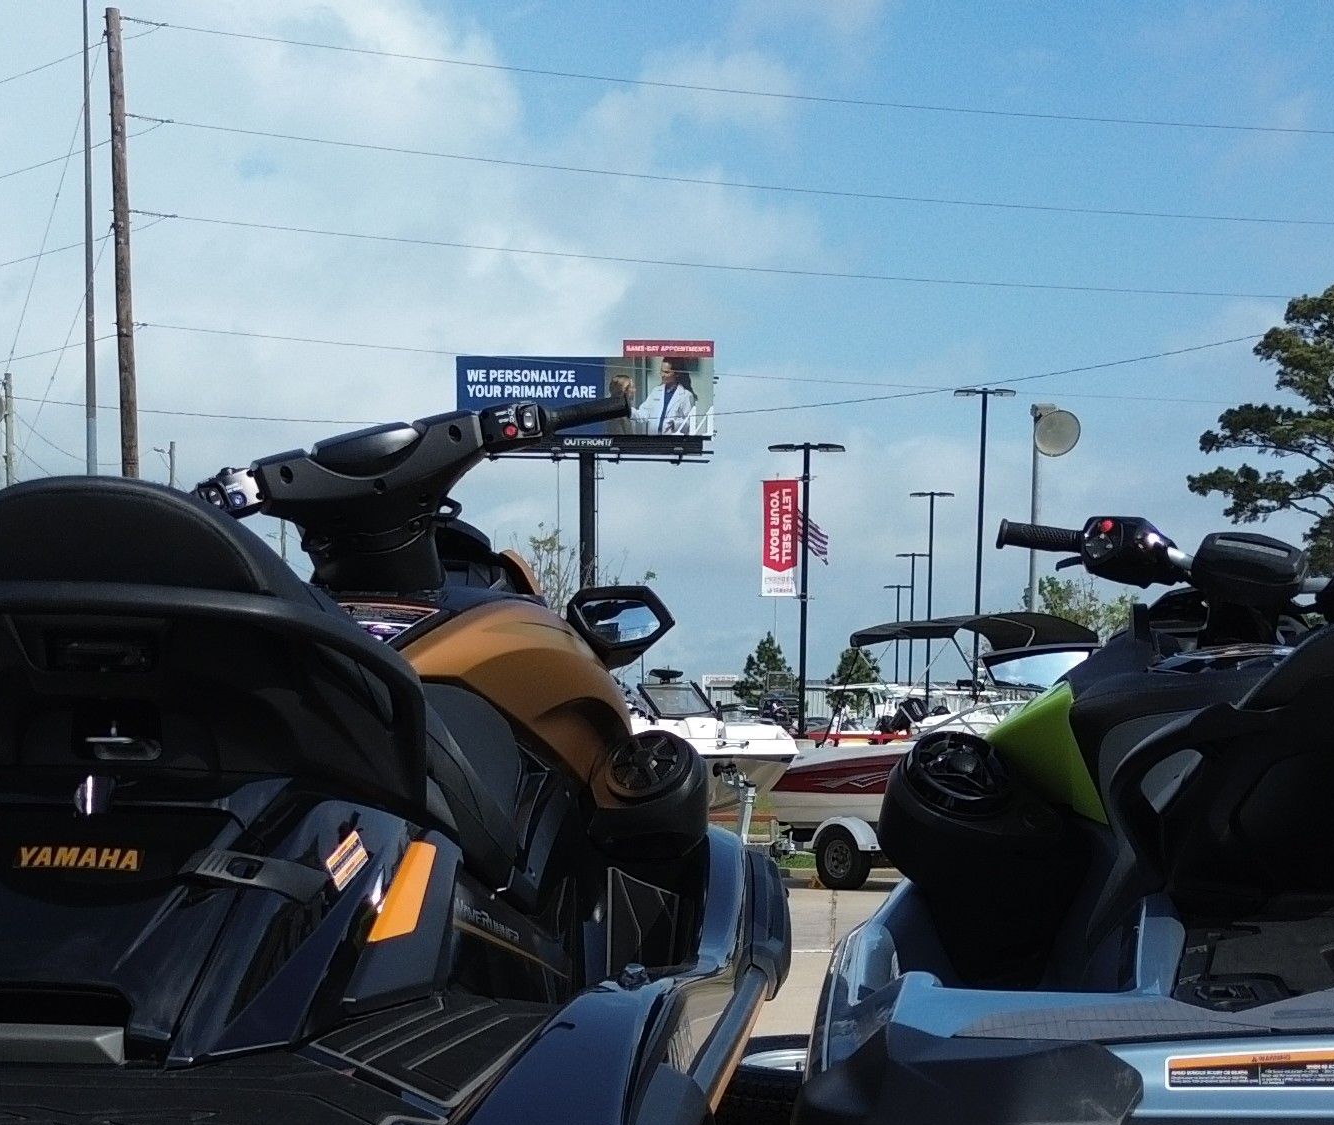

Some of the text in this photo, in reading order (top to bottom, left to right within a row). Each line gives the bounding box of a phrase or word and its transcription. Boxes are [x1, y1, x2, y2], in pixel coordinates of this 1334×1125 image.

[467, 370, 576, 383] WE PERSONALIZE
[467, 385, 597, 398] YOUR PRIMARY CARE
[770, 490, 780, 562] YOUR BOAT
[782, 488, 792, 564] LET US SELL
[19, 846, 141, 871] YAMAHA
